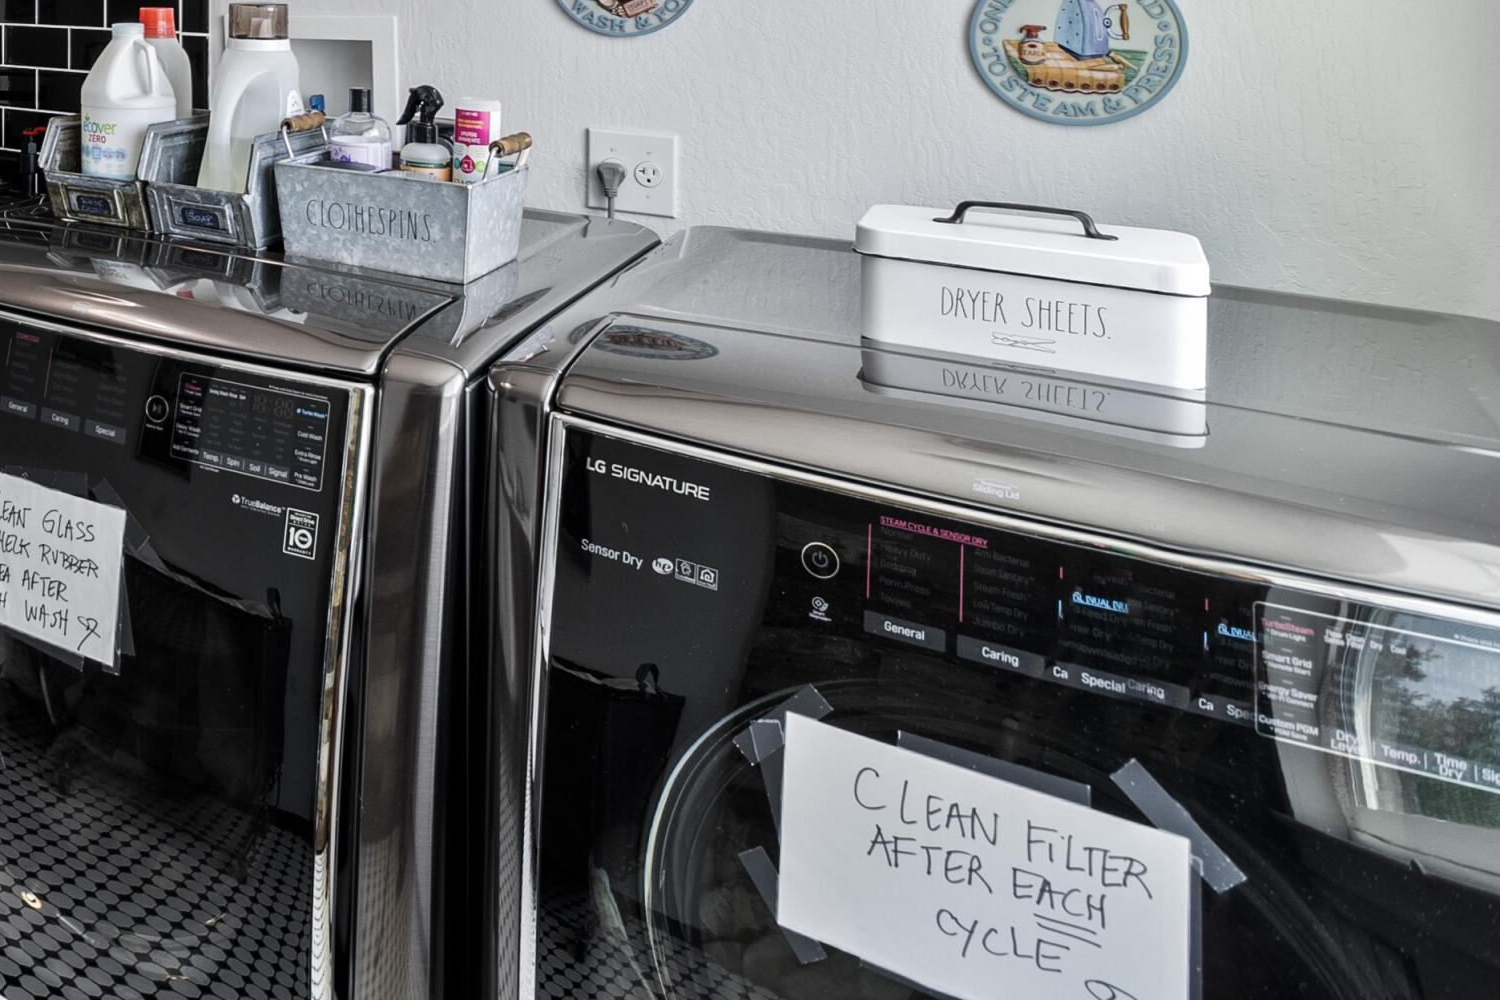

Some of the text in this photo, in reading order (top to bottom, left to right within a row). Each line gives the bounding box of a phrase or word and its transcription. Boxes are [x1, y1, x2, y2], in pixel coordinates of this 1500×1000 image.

[571, 0, 627, 32] WASH
[635, 15, 653, 29] &
[982, 32, 1177, 117] TO STEAM & PRESS
[84, 120, 116, 136] ecover
[88, 134, 106, 144] ZERO
[940, 286, 1111, 341] DRYER SHEETS.
[51, 413, 69, 425] Caring
[95, 425, 116, 437] Special
[226, 457, 240, 468] Spin
[249, 463, 261, 473] Soil
[268, 467, 288, 480] Signal
[586, 457, 710, 501] LG SIGNATURE
[42, 509, 96, 543] GLASS
[289, 526, 313, 549] 10
[880, 515, 907, 529] STEAM
[972, 536, 988, 547] DRY
[38, 543, 99, 580] RUBBER
[581, 538, 643, 570] Sensor Dry
[21, 568, 69, 603] AFTER
[24, 601, 70, 636] WASH
[884, 621, 925, 640] General
[982, 647, 1019, 667] Caring
[1081, 672, 1126, 694] Special
[1127, 678, 1165, 699] Caring
[1262, 650, 1313, 669] Smart Grid
[1258, 681, 1318, 702] Energy Saver
[1259, 714, 1319, 736] Custom PGM
[1336, 729, 1357, 744] Dry
[1381, 744, 1421, 764] Temp.
[1434, 752, 1467, 771] Time
[1439, 765, 1464, 782] Dry
[854, 766, 1000, 846] CLEAN
[867, 824, 1106, 929] AFTER EACH
[936, 908, 1071, 972] CYCLE
